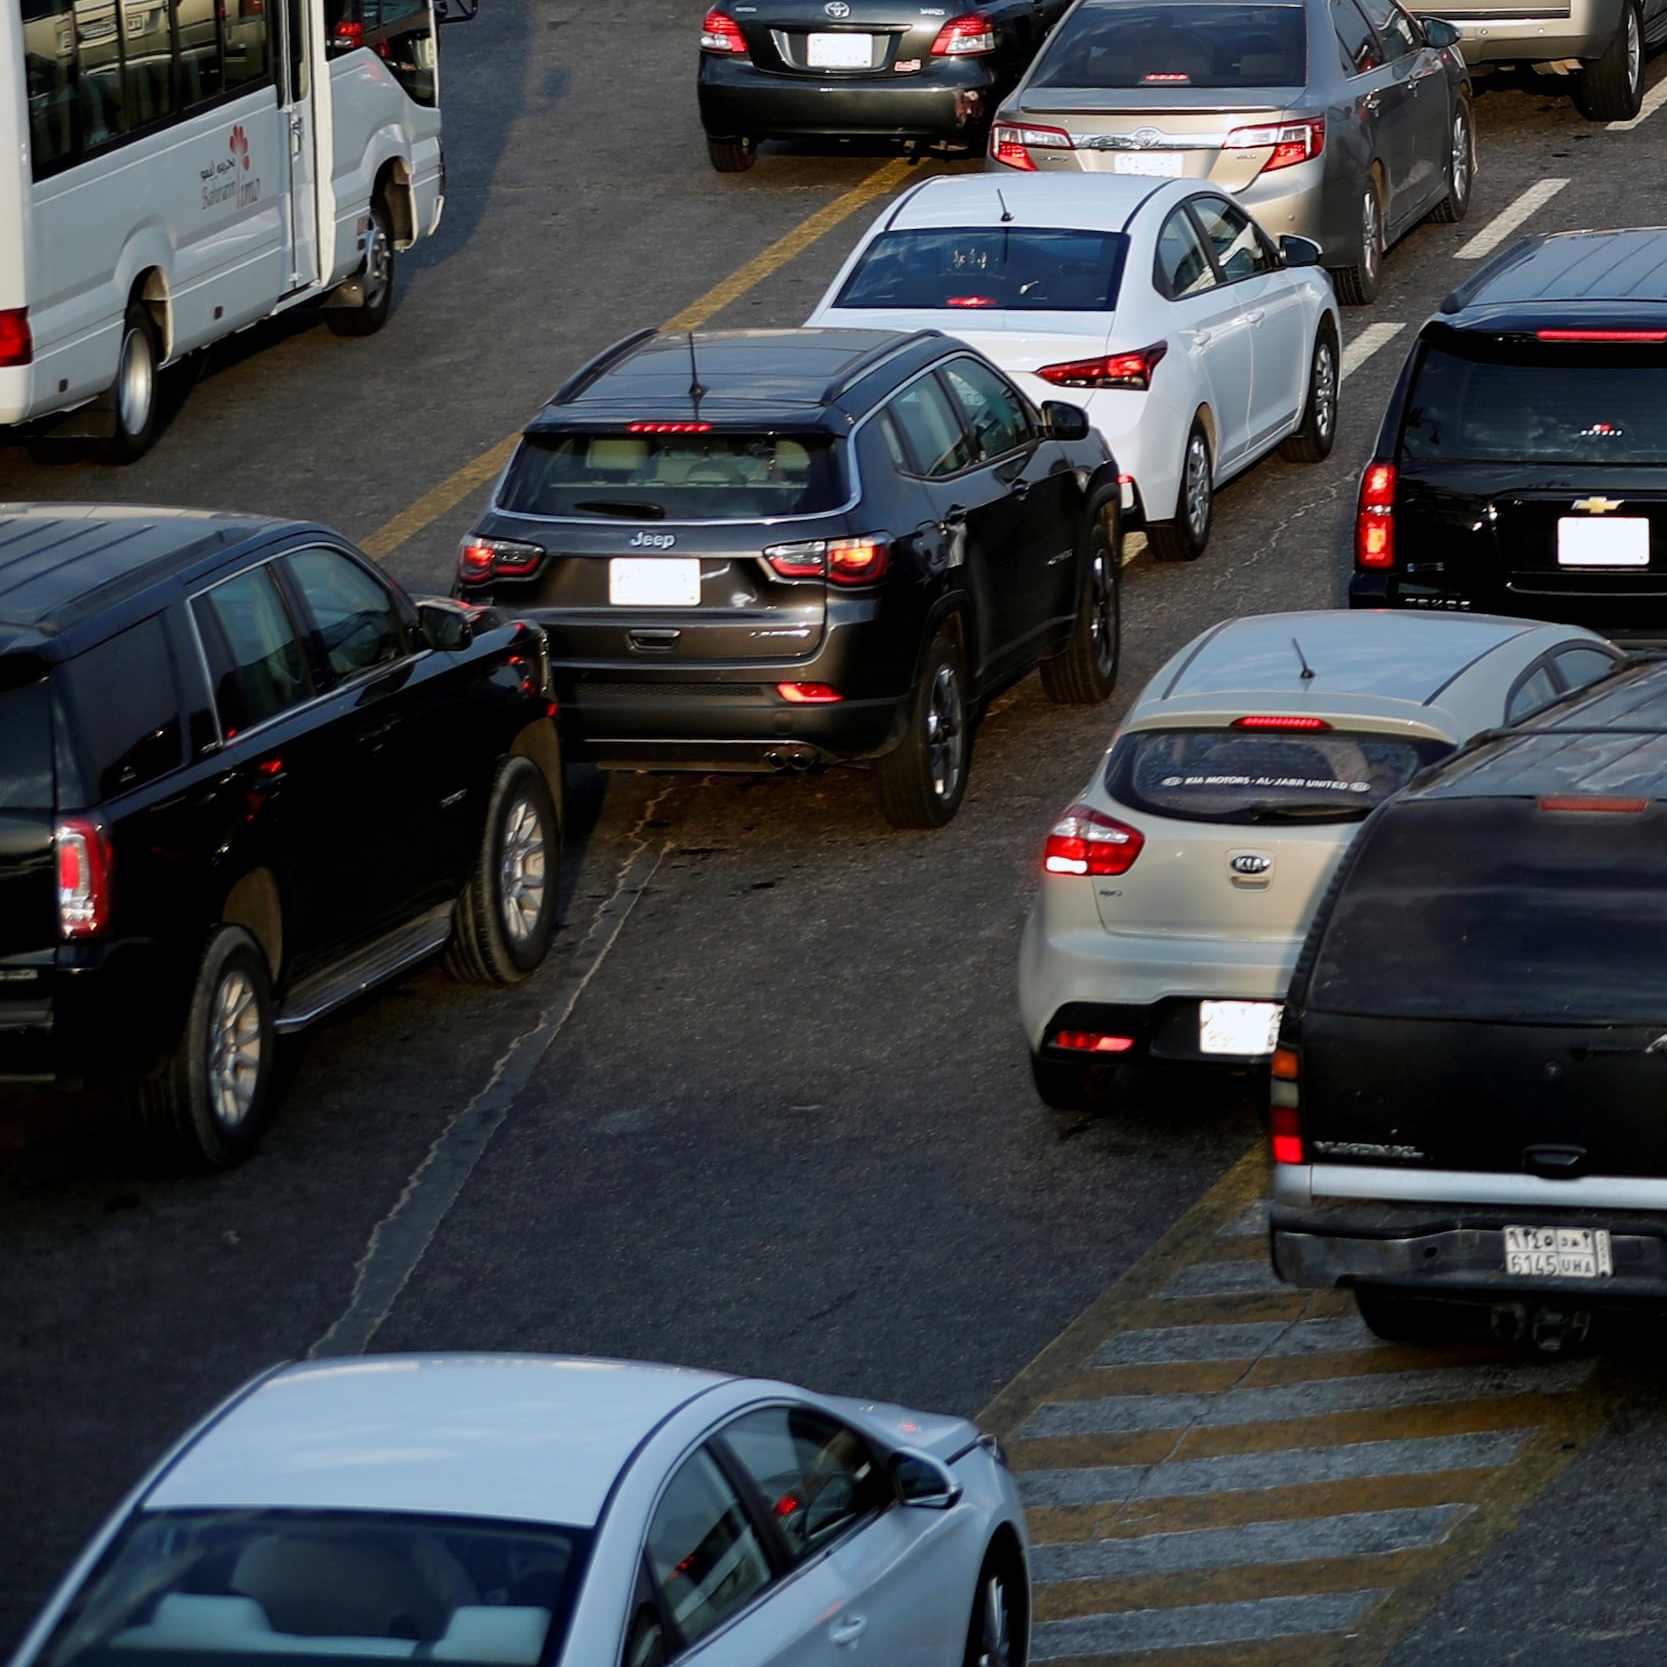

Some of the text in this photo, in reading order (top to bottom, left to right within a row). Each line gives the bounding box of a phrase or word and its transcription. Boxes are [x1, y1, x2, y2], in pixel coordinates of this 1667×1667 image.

[629, 530, 677, 549] Jeep
[1184, 776, 1204, 786] KIA
[1204, 775, 1250, 786] MOTORS
[1306, 780, 1349, 791] UNITED
[1509, 1253, 1592, 1276] 6145 UHA
